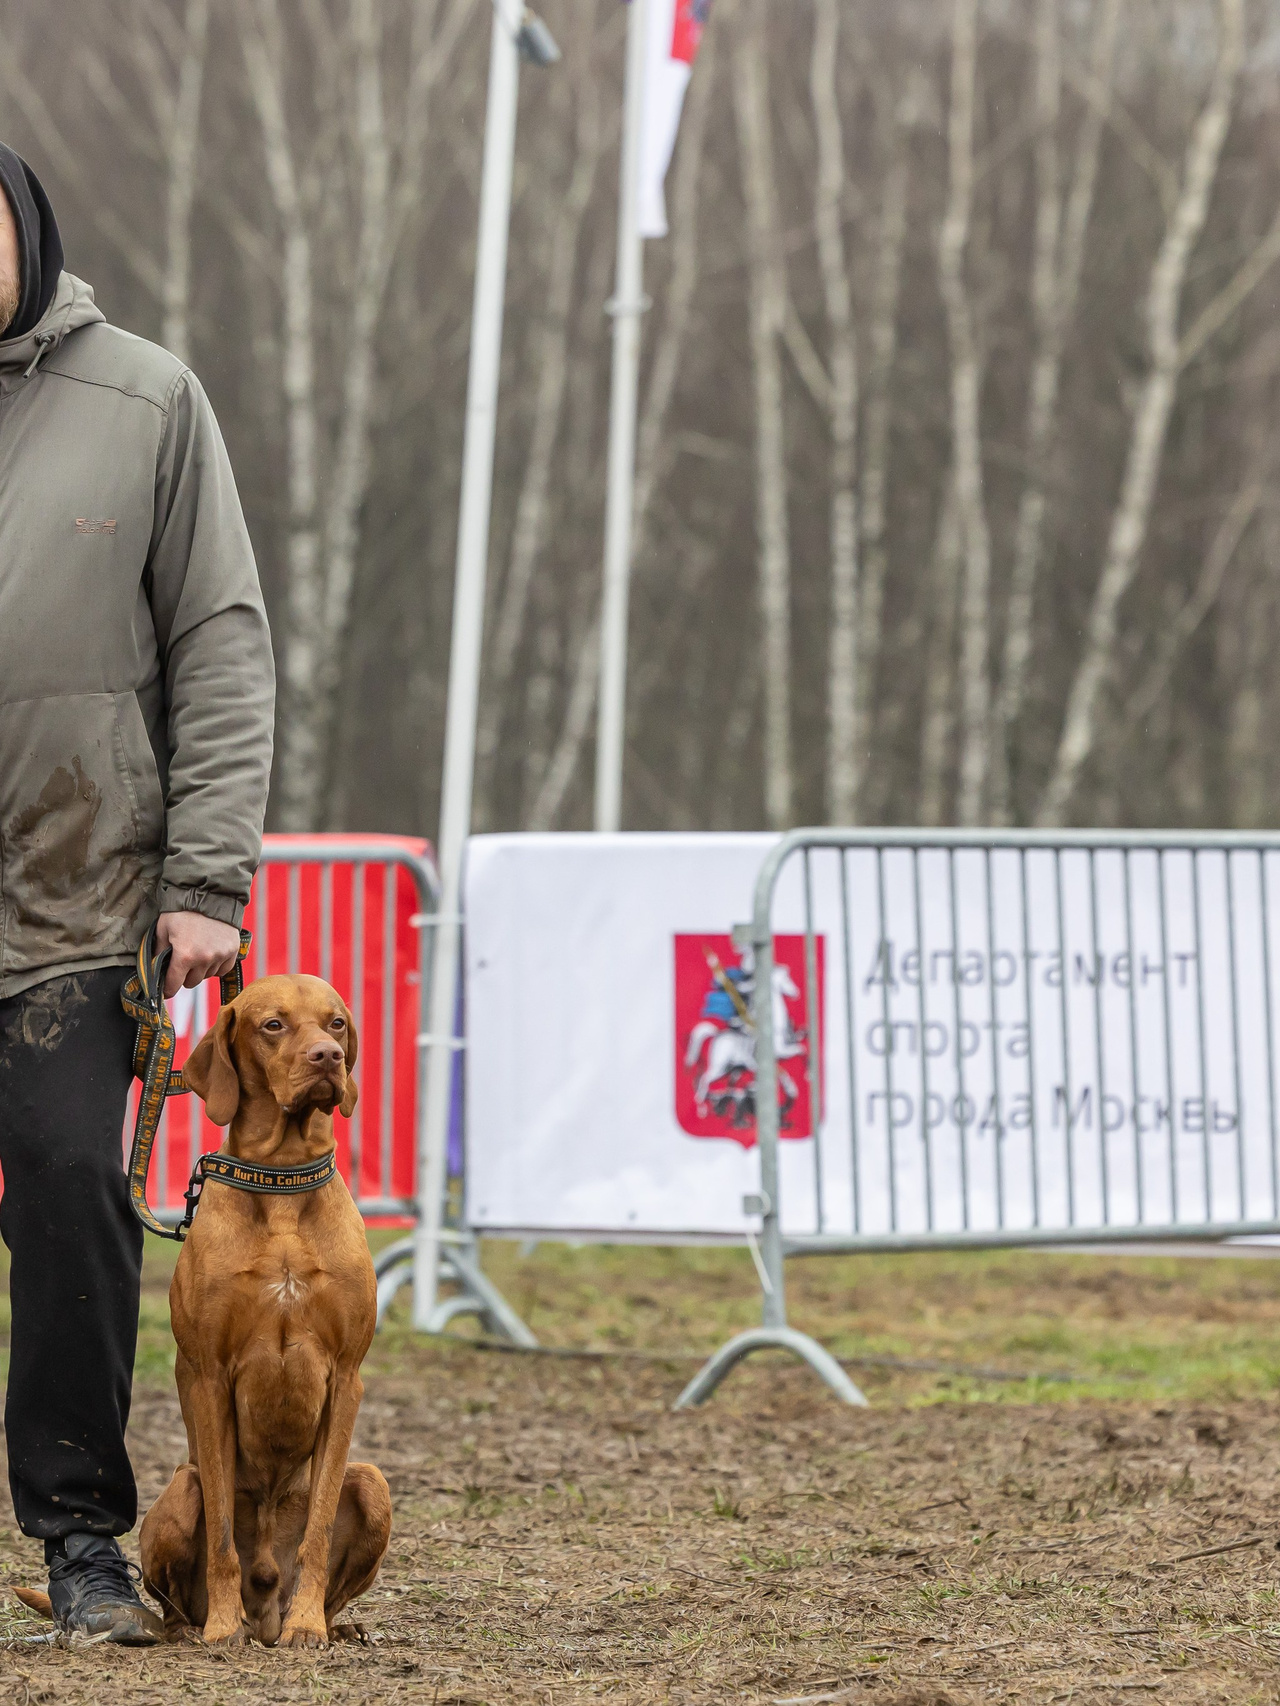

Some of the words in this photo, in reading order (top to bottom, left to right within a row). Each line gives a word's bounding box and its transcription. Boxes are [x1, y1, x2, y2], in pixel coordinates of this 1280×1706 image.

[863, 938, 1198, 995] Департамент
[865, 1018, 1032, 1067] спорта
[143, 1056, 168, 1127] Collection
[866, 1090, 1034, 1141] города
[234, 1168, 273, 1184] Hurtta
[276, 1167, 330, 1185] Collection
